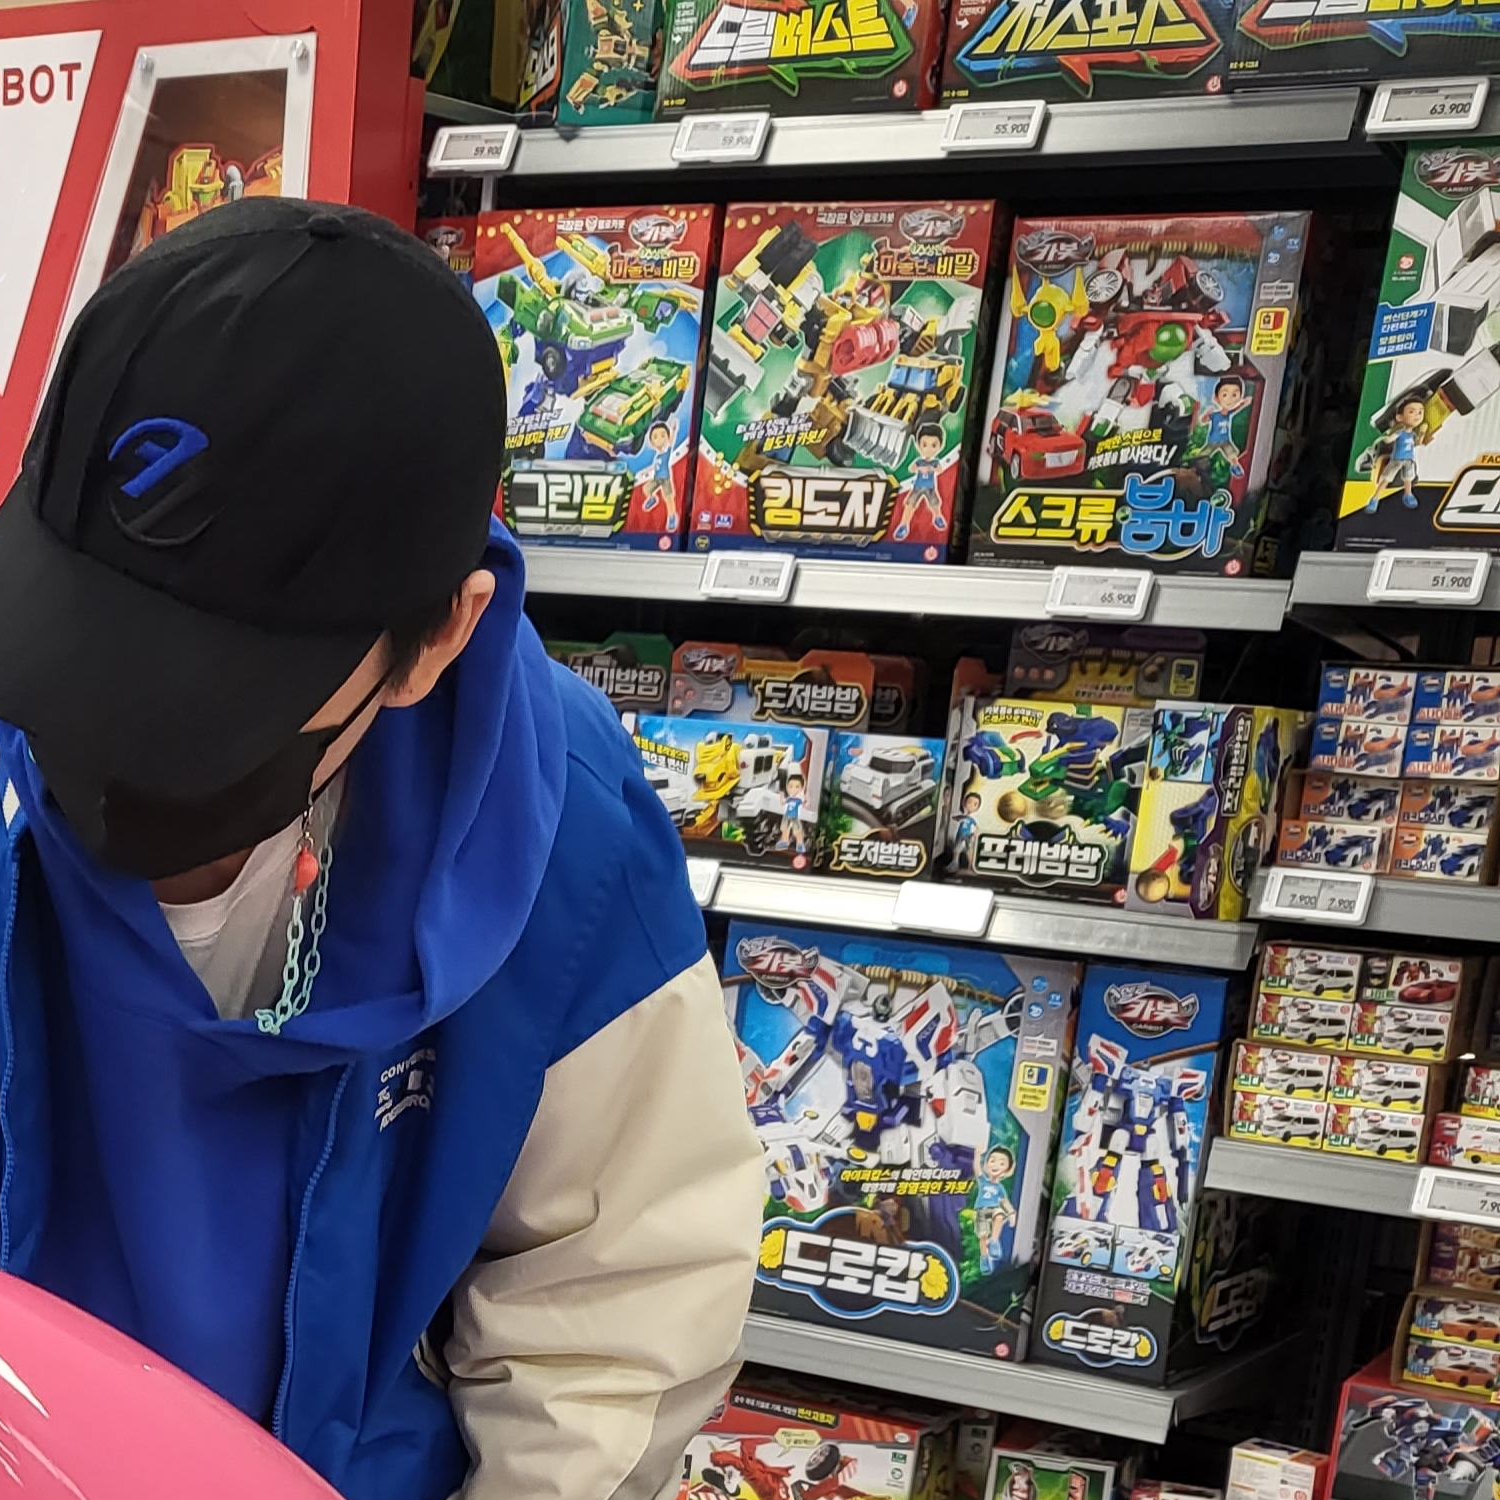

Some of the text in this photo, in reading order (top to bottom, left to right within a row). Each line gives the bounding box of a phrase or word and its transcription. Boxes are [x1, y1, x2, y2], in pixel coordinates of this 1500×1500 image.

[690, 0, 896, 67] 드릴버스트
[1432, 161, 1491, 183] 카봇
[937, 253, 974, 276] 비밀
[1030, 243, 1079, 261] 카봇
[663, 256, 695, 279] 비밀
[1121, 428, 1163, 447] 스핀으로
[1119, 443, 1178, 467] 발사한다!
[511, 473, 626, 521] 그린팜
[760, 477, 887, 529] 킹도저
[998, 494, 1117, 544] 스크류
[763, 681, 860, 715] 도저밤밤
[839, 839, 921, 867] 도저밤밤
[978, 836, 1102, 879] 포레밤밤
[750, 951, 803, 973] 카봇
[1118, 999, 1179, 1020] 카봇
[943, 1180, 974, 1194] 카봇!
[781, 1230, 928, 1304] 드로캅
[1061, 1319, 1141, 1360] 드로캅
